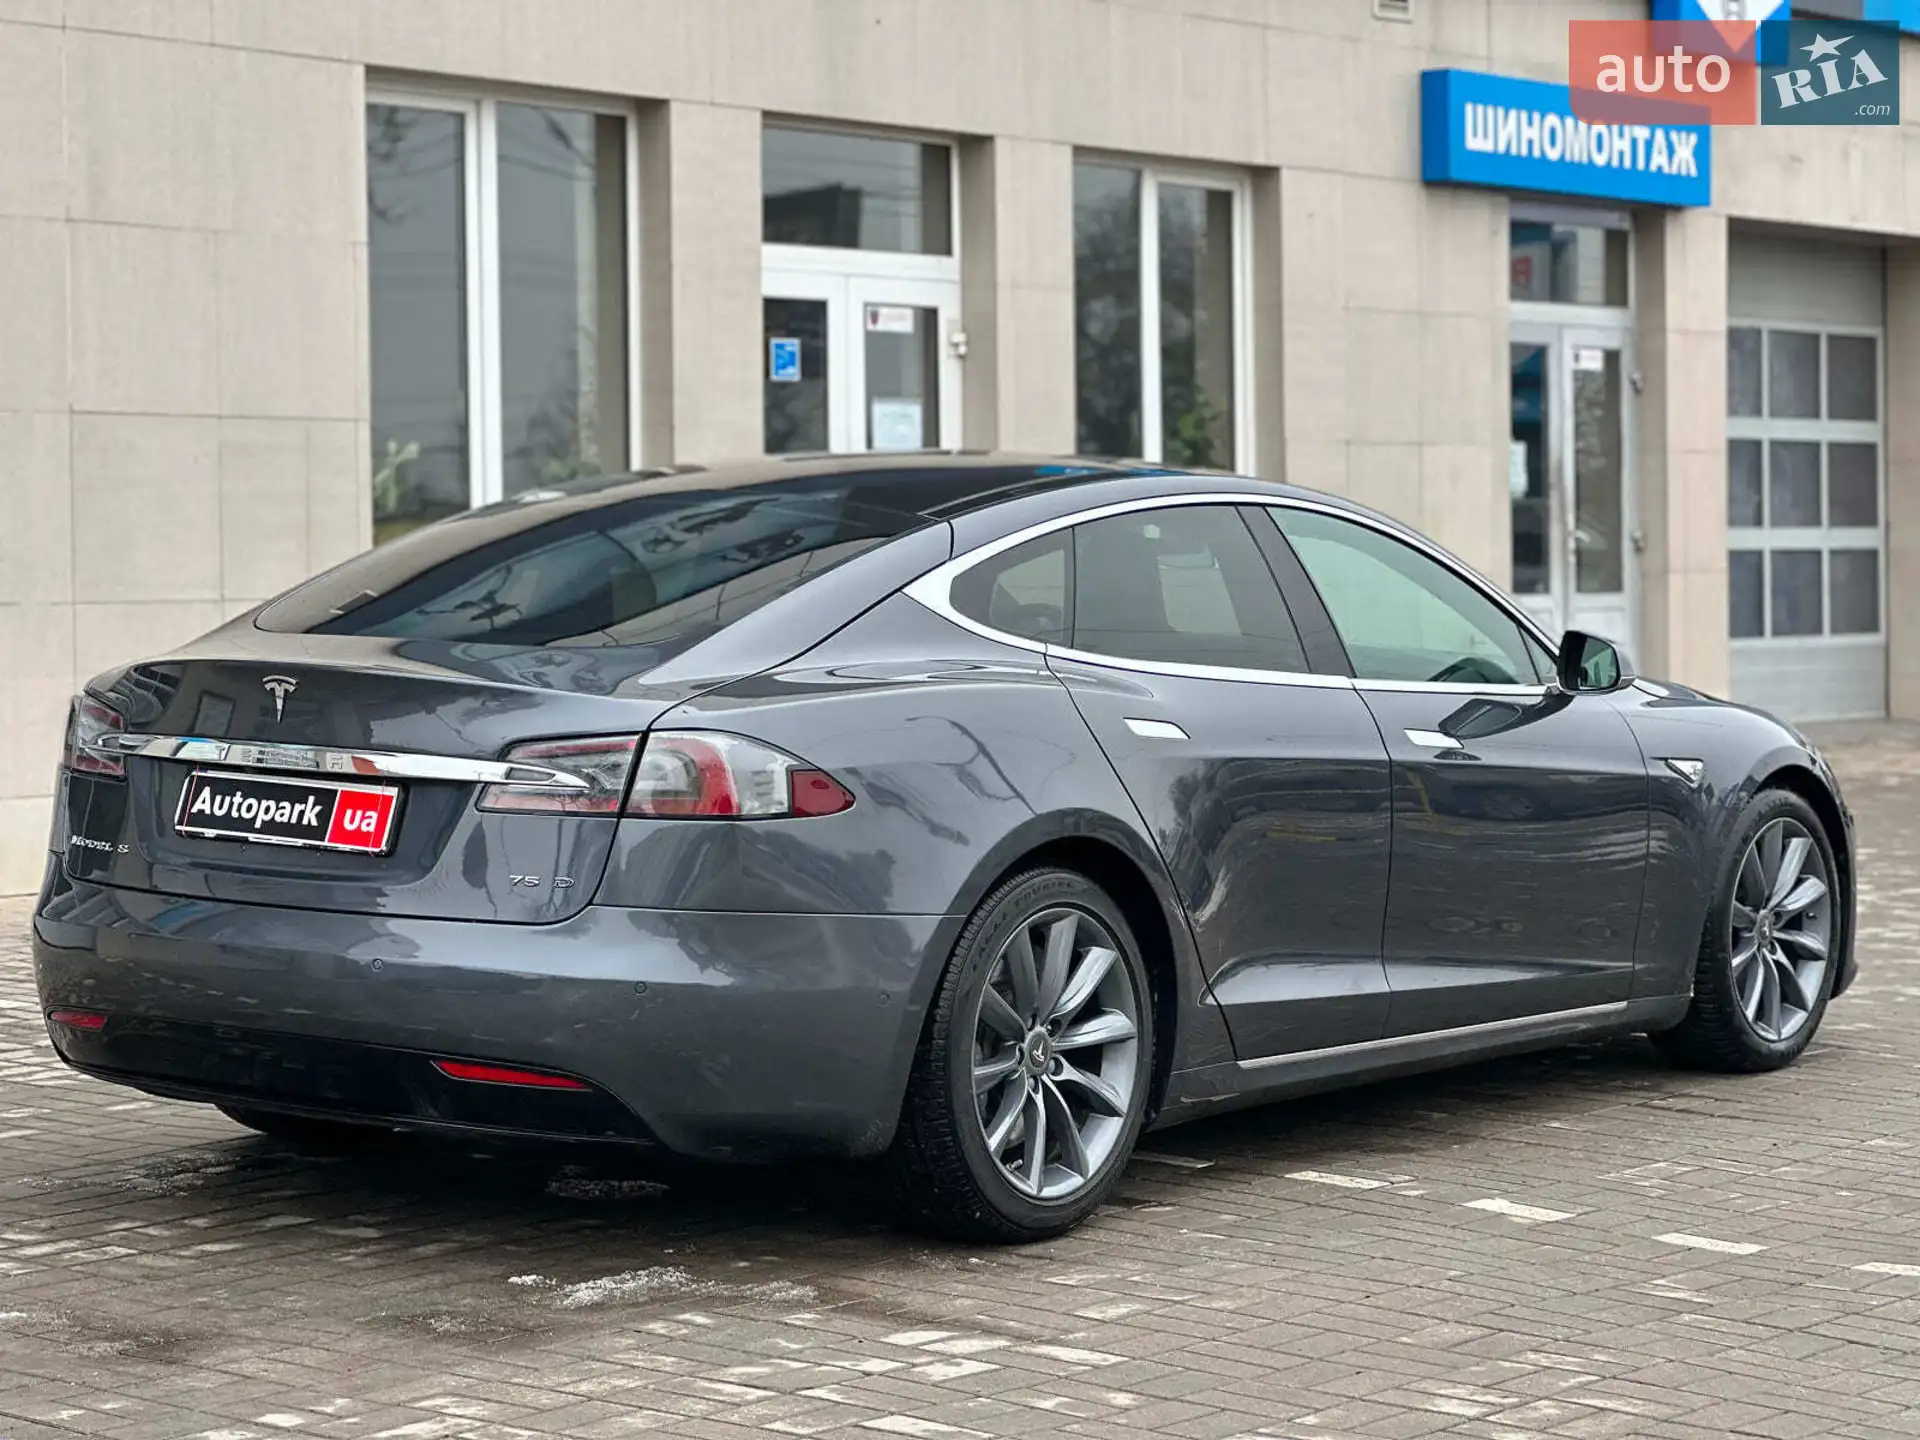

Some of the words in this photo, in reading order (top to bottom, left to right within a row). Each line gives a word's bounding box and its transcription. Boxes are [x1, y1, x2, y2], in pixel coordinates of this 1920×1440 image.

[1464, 101, 1698, 177] ШИНОМОНТАЖ
[190, 786, 323, 829] Autopark
[343, 808, 379, 832] ua
[509, 874, 540, 887] 75
